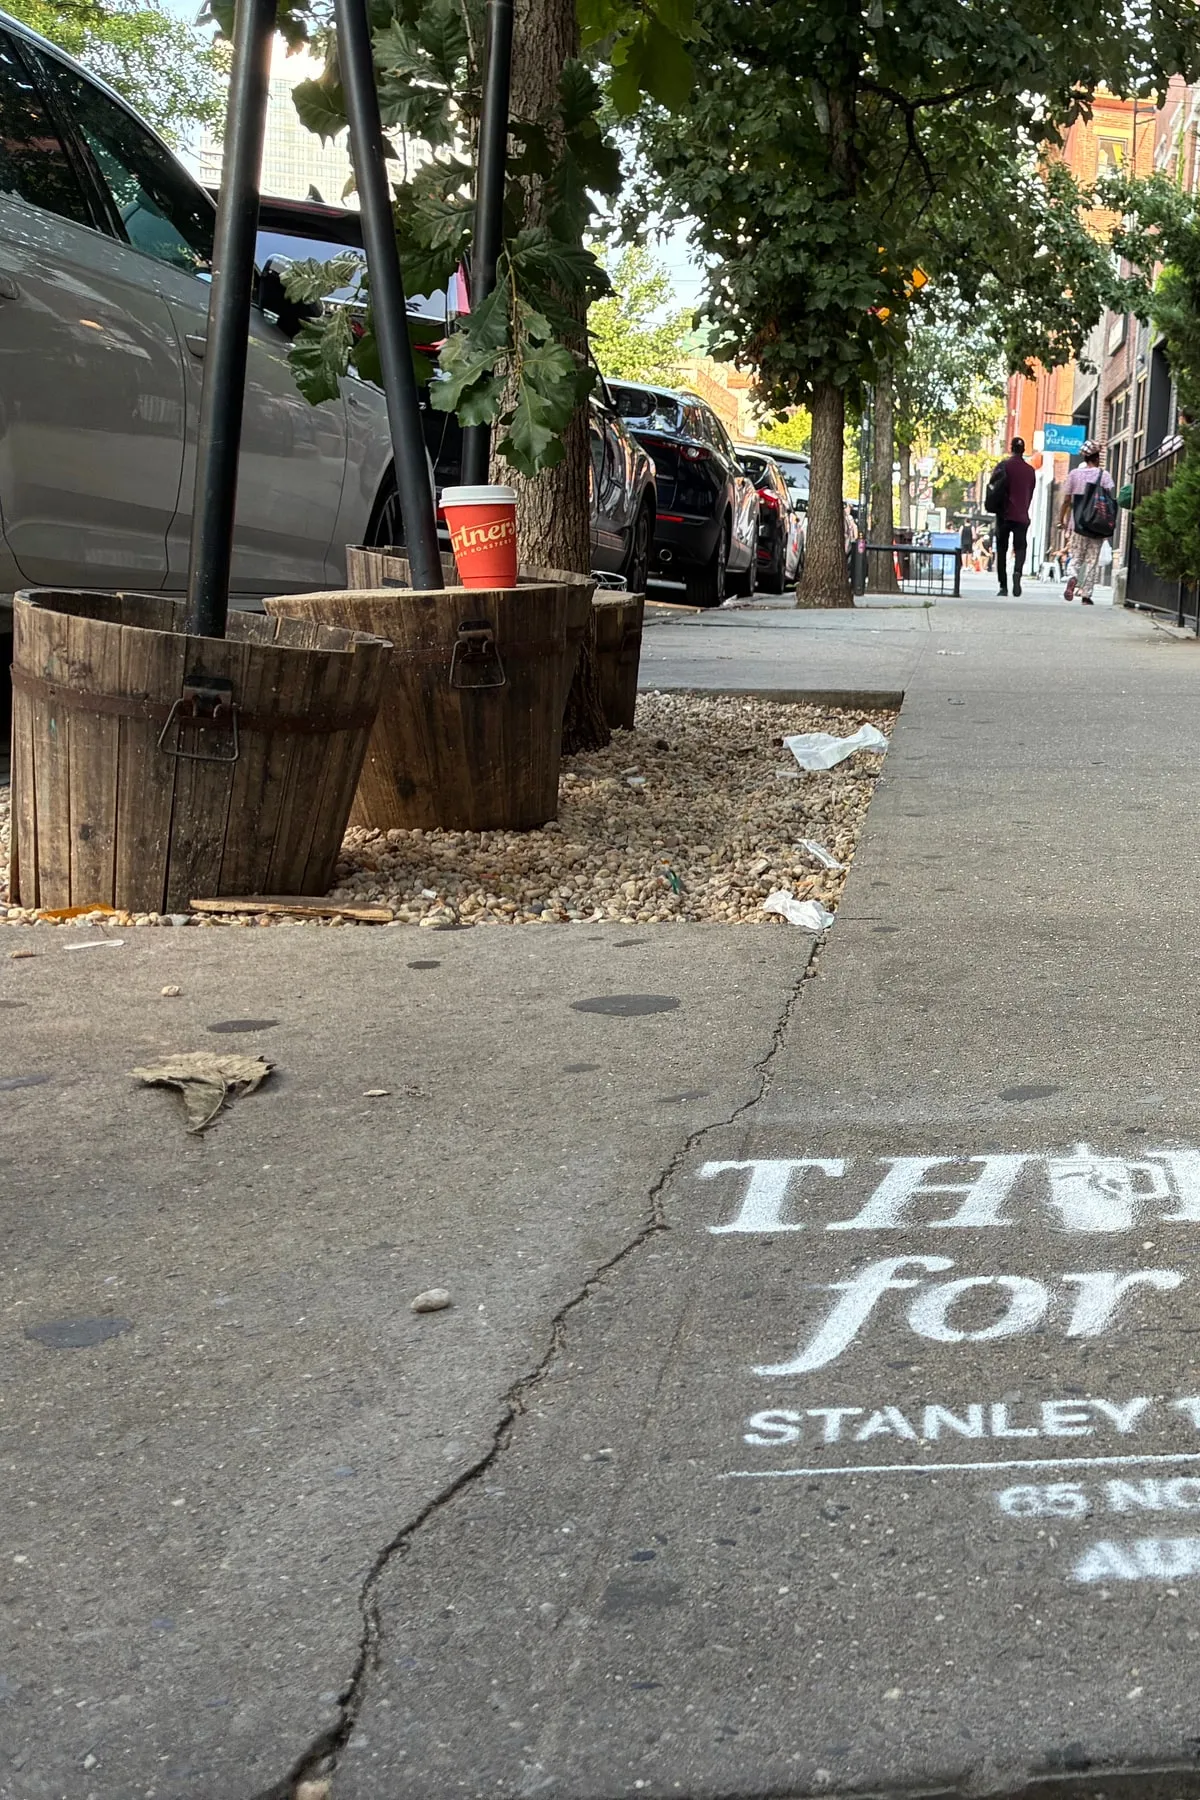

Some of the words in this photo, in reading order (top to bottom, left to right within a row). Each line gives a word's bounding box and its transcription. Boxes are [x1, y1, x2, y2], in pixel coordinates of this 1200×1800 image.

[451, 521, 515, 553] rtners
[751, 1255, 1185, 1376] for
[743, 1398, 1151, 1447] STANLEY
[998, 1482, 1091, 1519] 65
